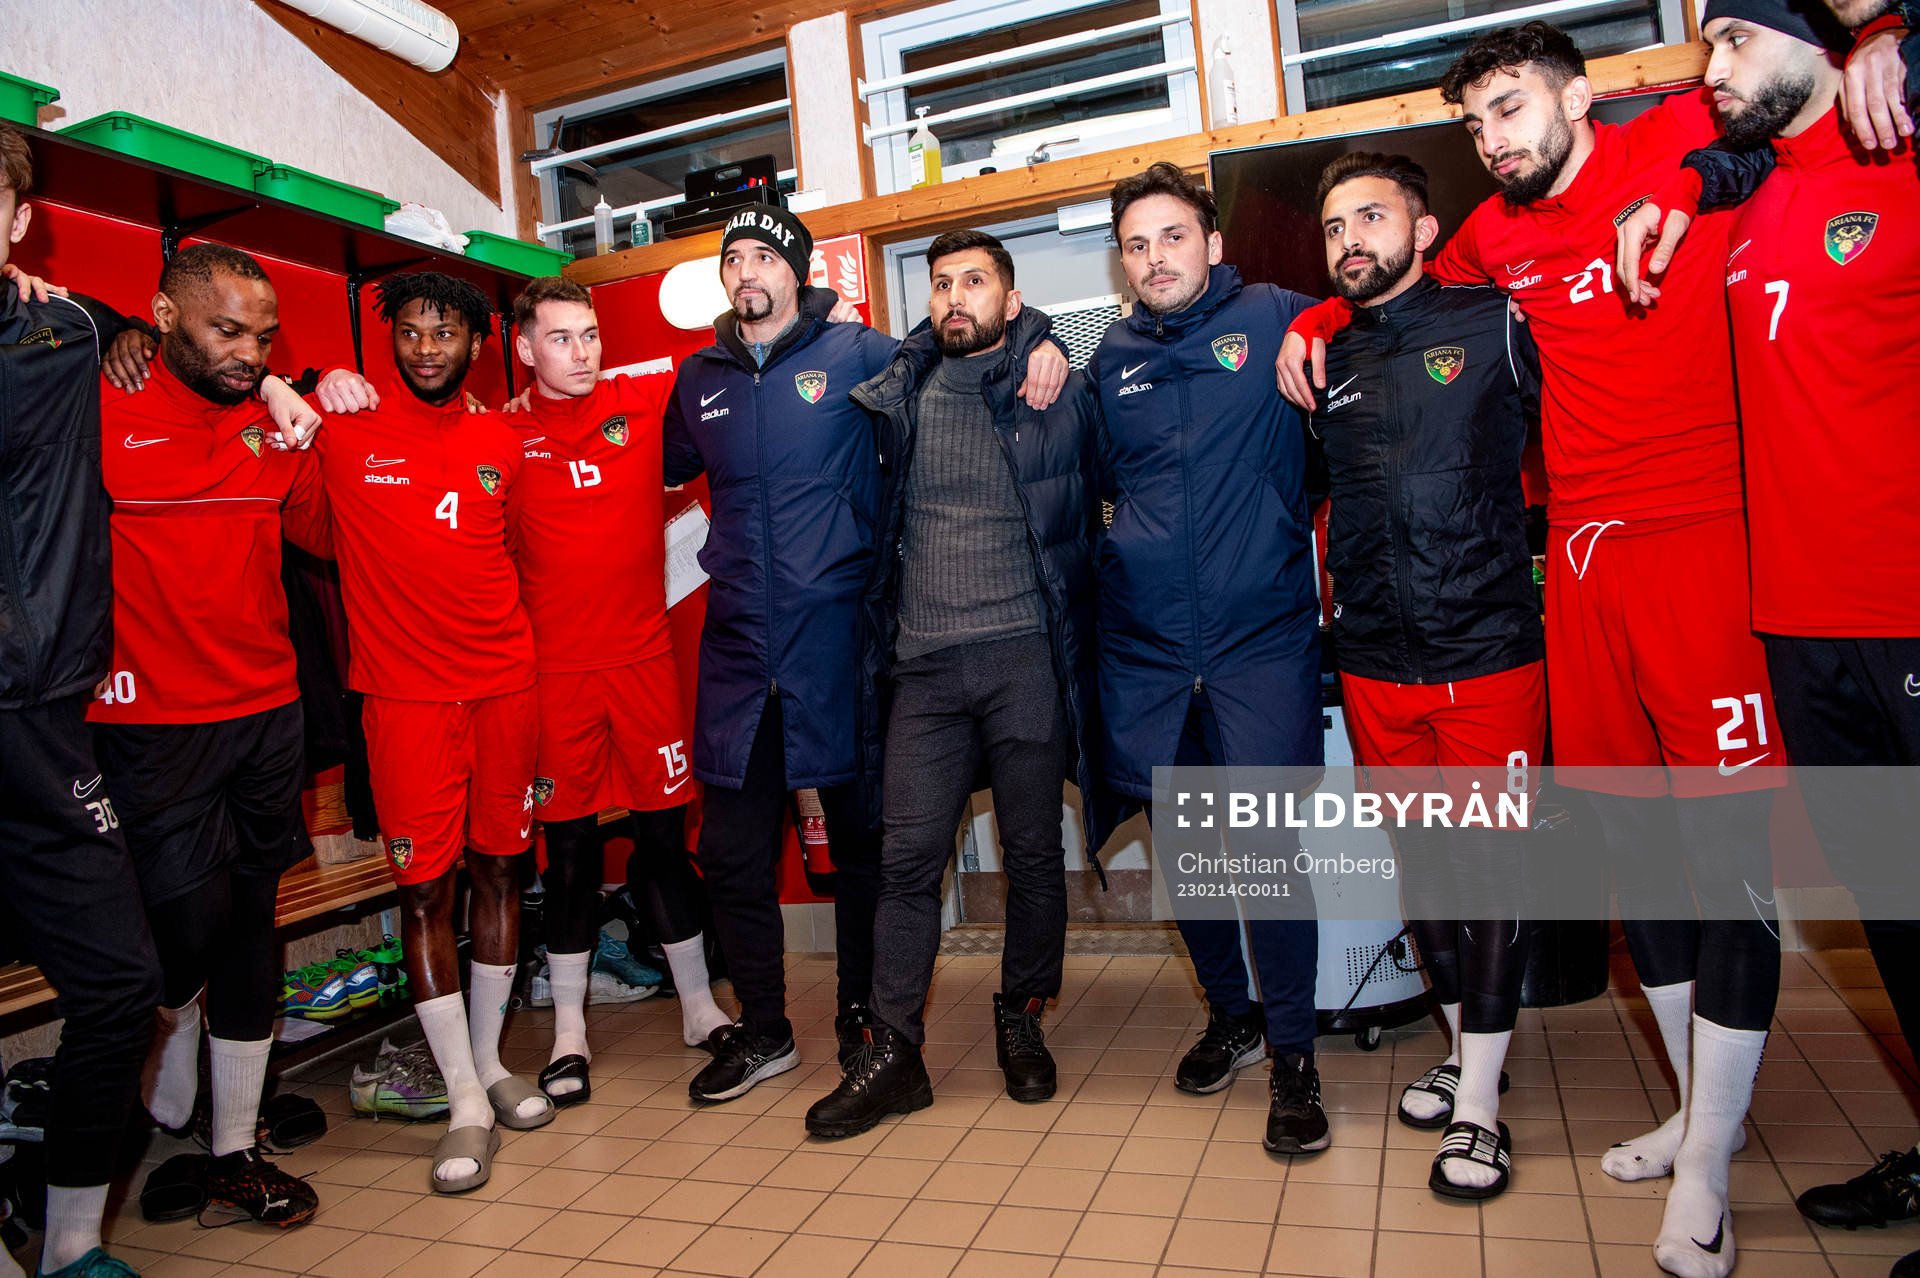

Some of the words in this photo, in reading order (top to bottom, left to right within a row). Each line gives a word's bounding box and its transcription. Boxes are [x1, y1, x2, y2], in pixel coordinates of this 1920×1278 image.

[760, 215, 795, 247] DAY
[1830, 215, 1862, 228] ARIANA
[1863, 215, 1875, 224] FC
[1562, 258, 1613, 304] 21
[1765, 280, 1790, 341] 7
[1212, 336, 1236, 347] ARIANA
[1426, 349, 1452, 359] ARIANA
[797, 373, 817, 381] ARIANA
[1118, 382, 1152, 397] stadium
[701, 408, 729, 421] stadium
[1328, 392, 1361, 412] stadium
[365, 474, 410, 485] stadium
[568, 459, 602, 488] 15
[435, 492, 459, 529] 4
[1712, 693, 1767, 750] 21
[658, 740, 687, 778] 15
[1507, 750, 1528, 795] 8
[85, 798, 119, 834] 30
